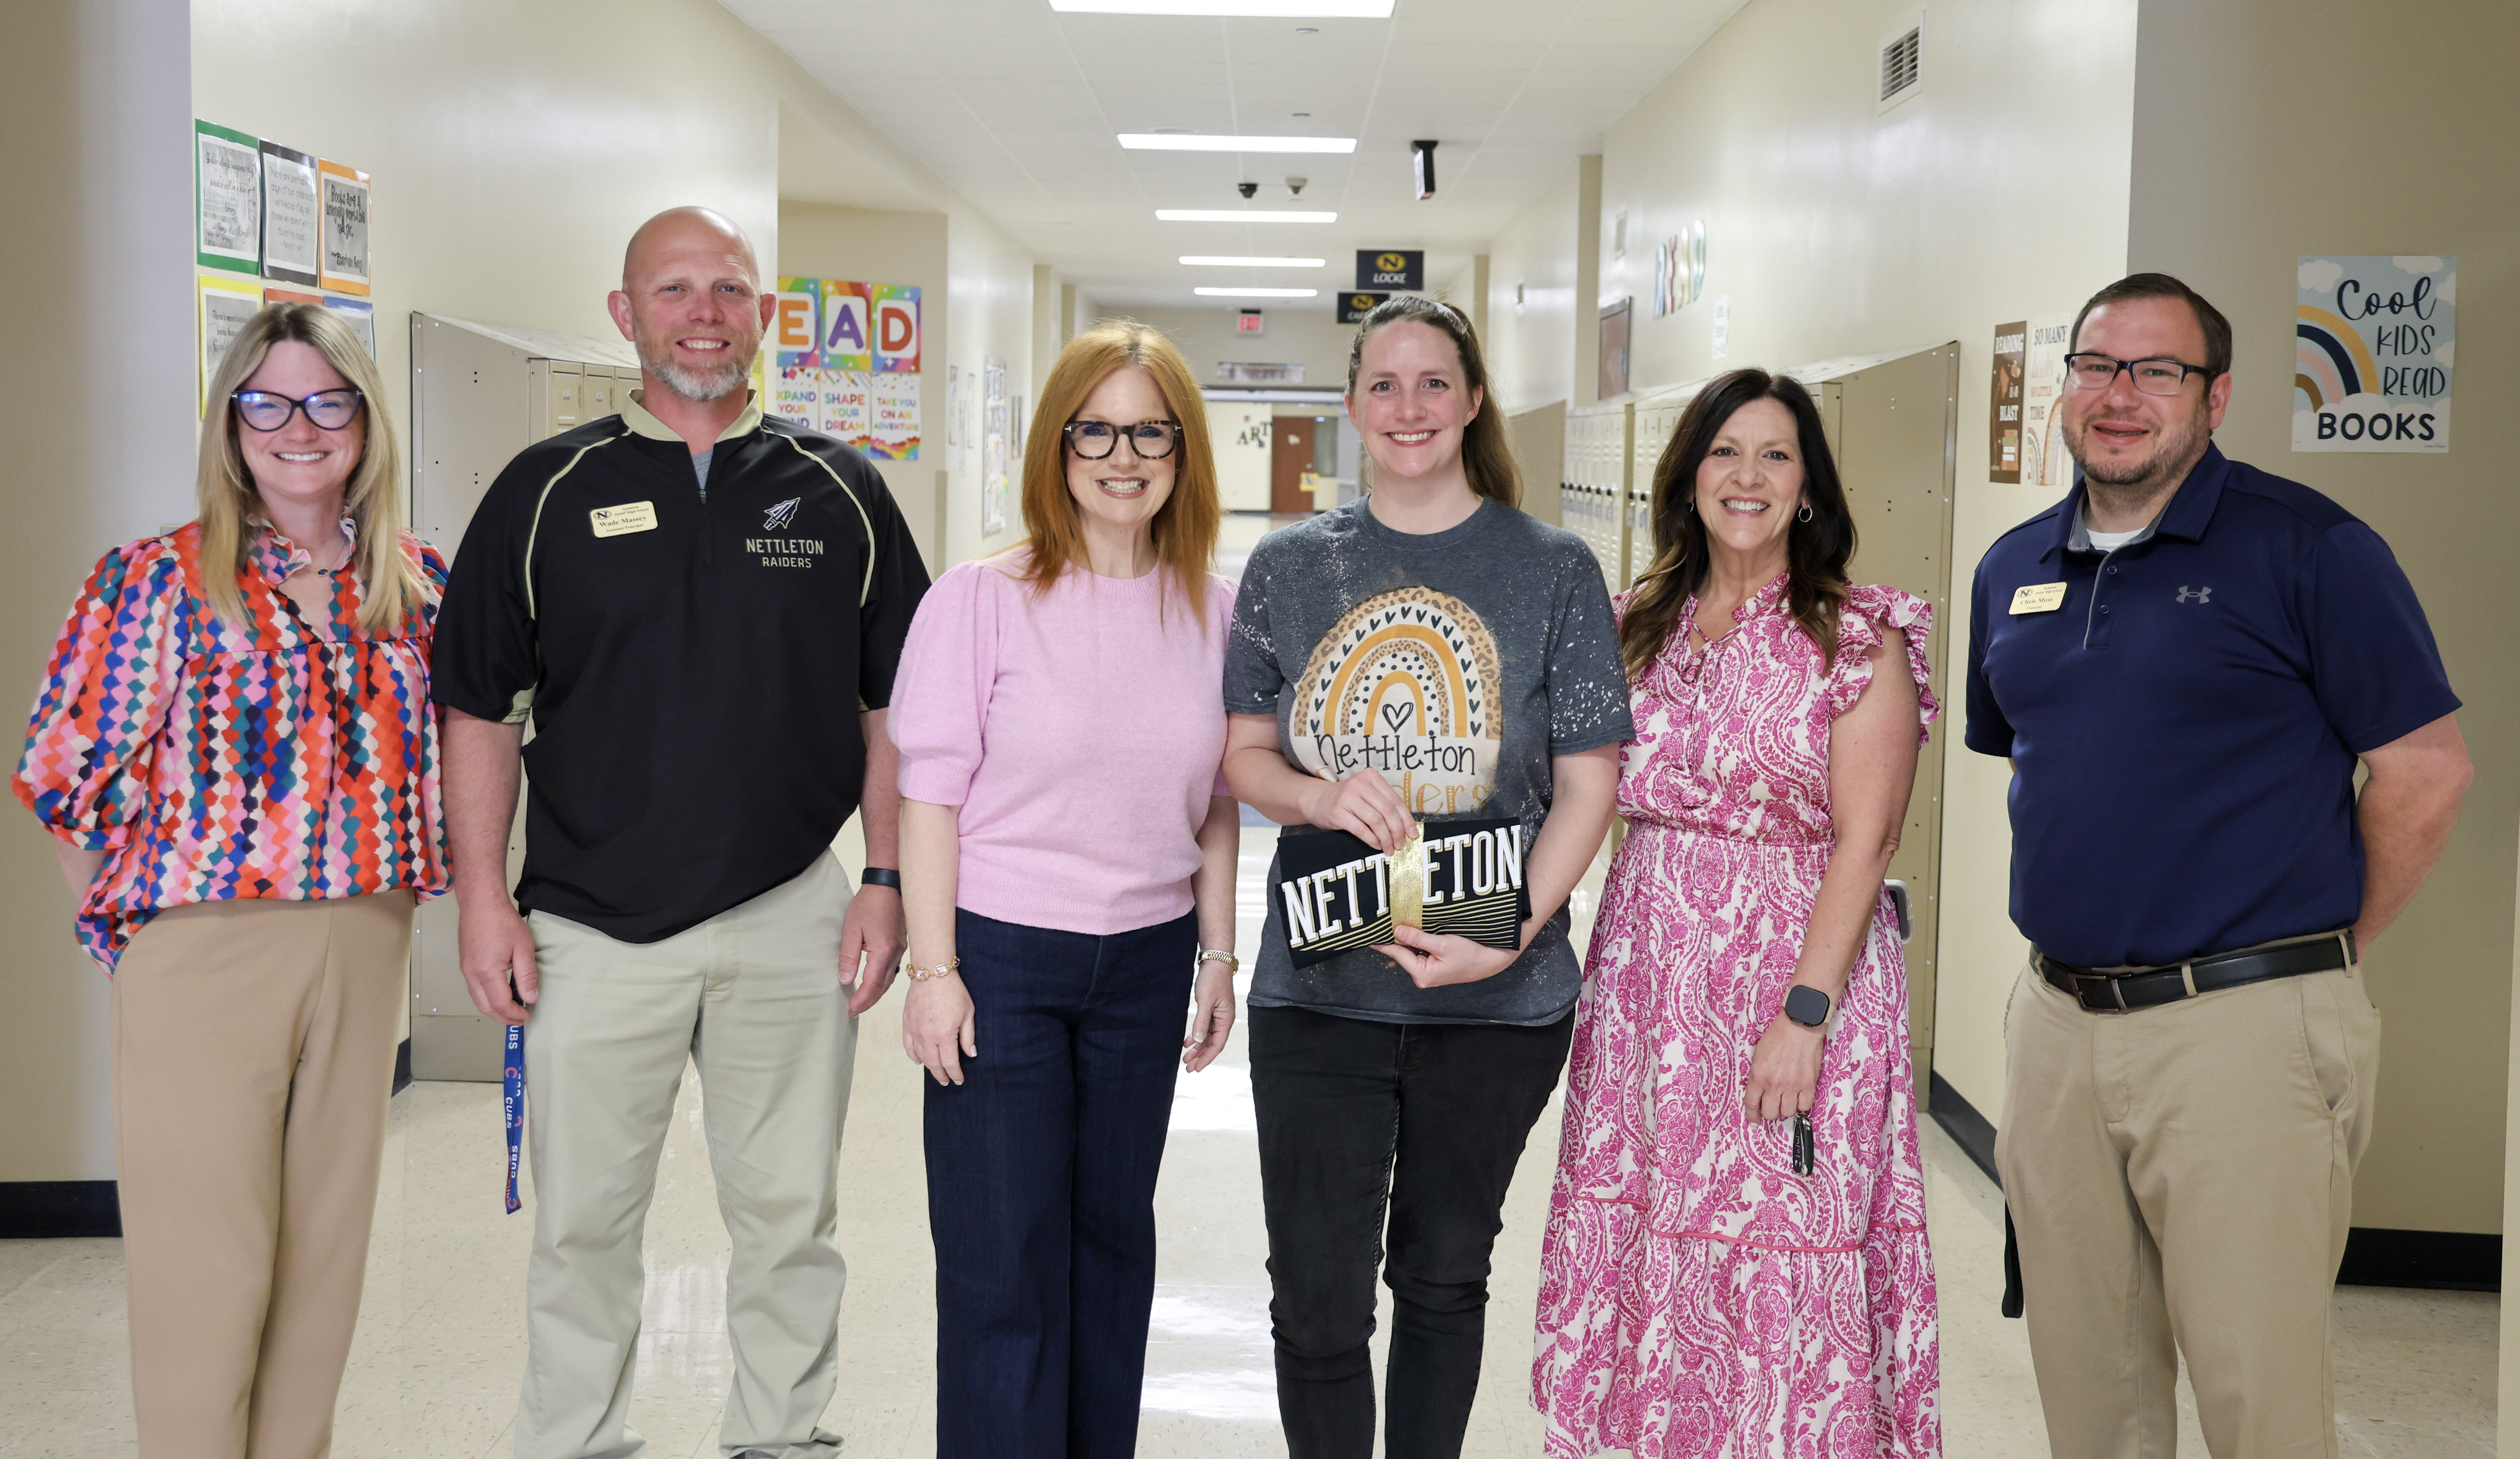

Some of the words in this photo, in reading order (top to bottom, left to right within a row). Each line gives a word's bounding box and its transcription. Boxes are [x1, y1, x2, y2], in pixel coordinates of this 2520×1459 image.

[2337, 276, 2437, 320] Cool
[779, 300, 913, 351] EAD
[1240, 315, 1261, 331] EXIT
[2377, 324, 2435, 356] KIDS
[776, 390, 816, 402] XPAND
[825, 392, 865, 405] SHAPE
[877, 397, 897, 406] TAKE
[899, 398, 917, 407] YOU
[778, 404, 807, 414] YOUR
[832, 408, 859, 417] YOUR
[881, 409, 895, 419] ON
[898, 410, 912, 419] AN
[1999, 405, 2020, 422] BLAST
[826, 420, 865, 431] DREAM
[2318, 413, 2435, 441] BOOKS
[596, 511, 609, 519] N
[621, 516, 647, 524] Massey
[746, 538, 824, 555] NETTLETON
[762, 557, 812, 568] RAIDERS
[1391, 771, 1489, 814] ders
[1281, 824, 1522, 949] NETTETON
[508, 1026, 519, 1050] UBS
